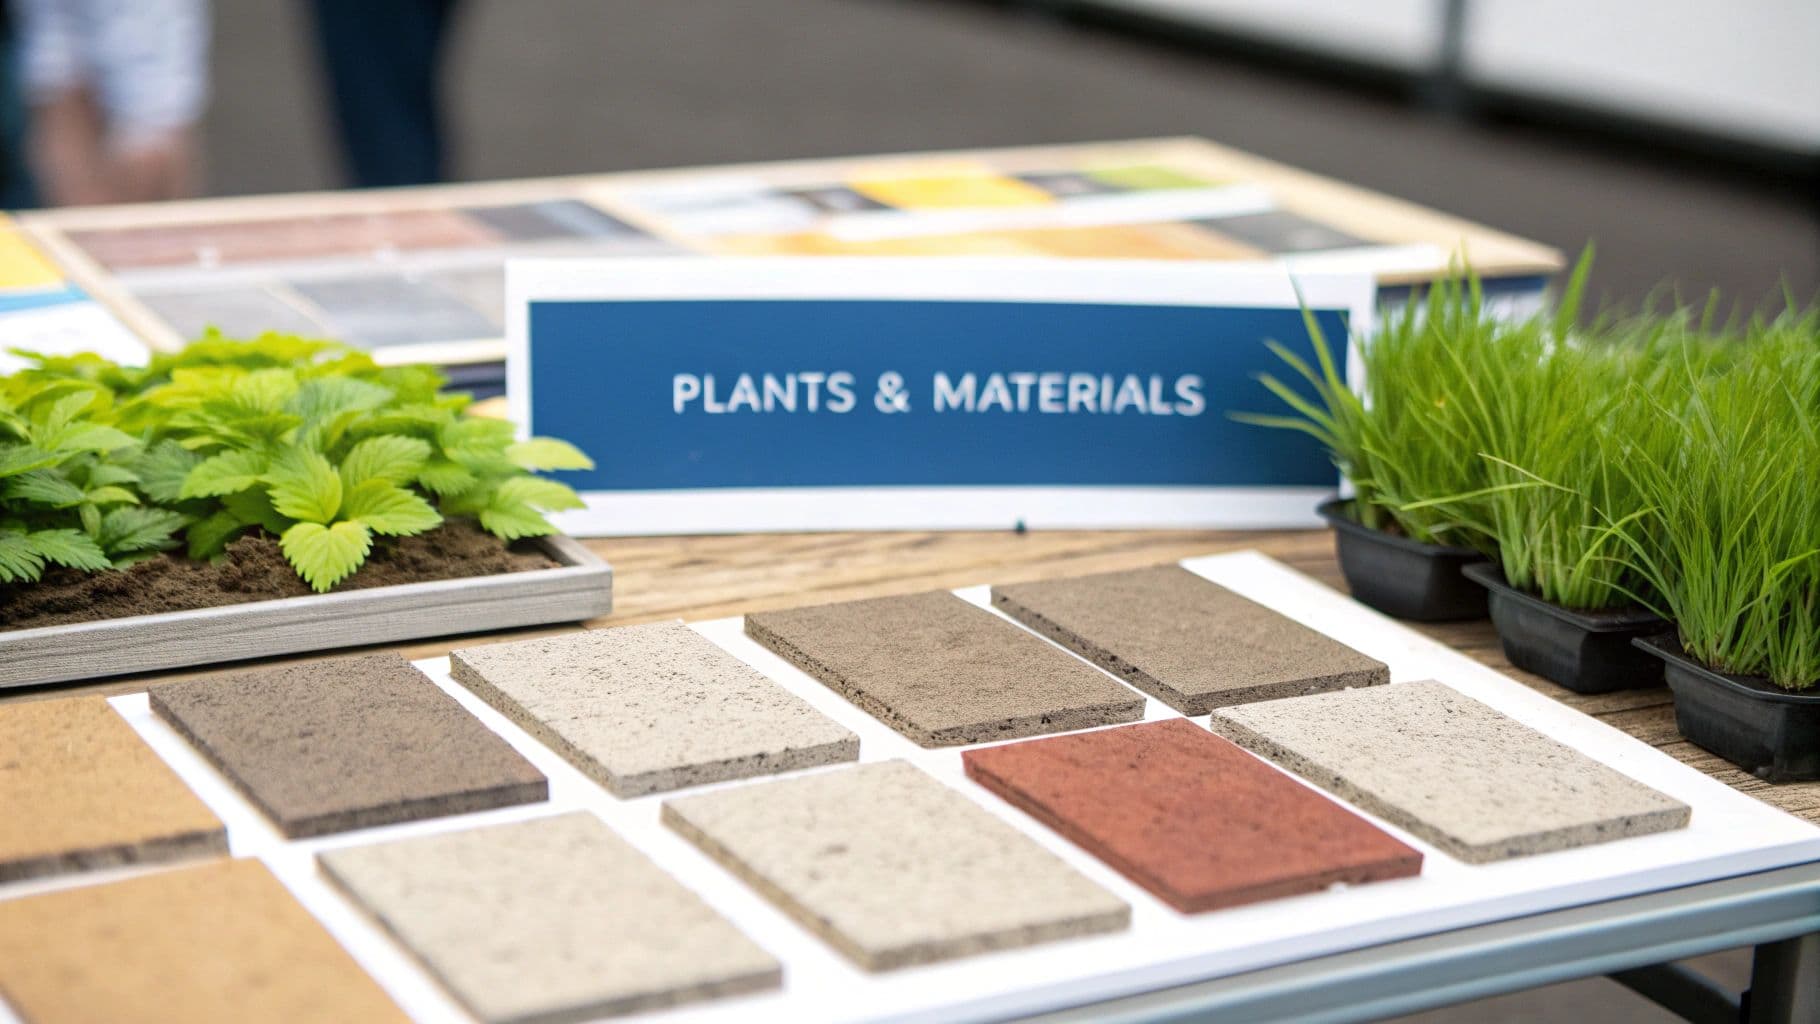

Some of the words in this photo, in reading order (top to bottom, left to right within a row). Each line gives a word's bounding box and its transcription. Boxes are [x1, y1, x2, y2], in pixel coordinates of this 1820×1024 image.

[673, 372, 856, 413] PLANTS
[874, 372, 910, 413] &
[933, 373, 1204, 415] MATERIALS
